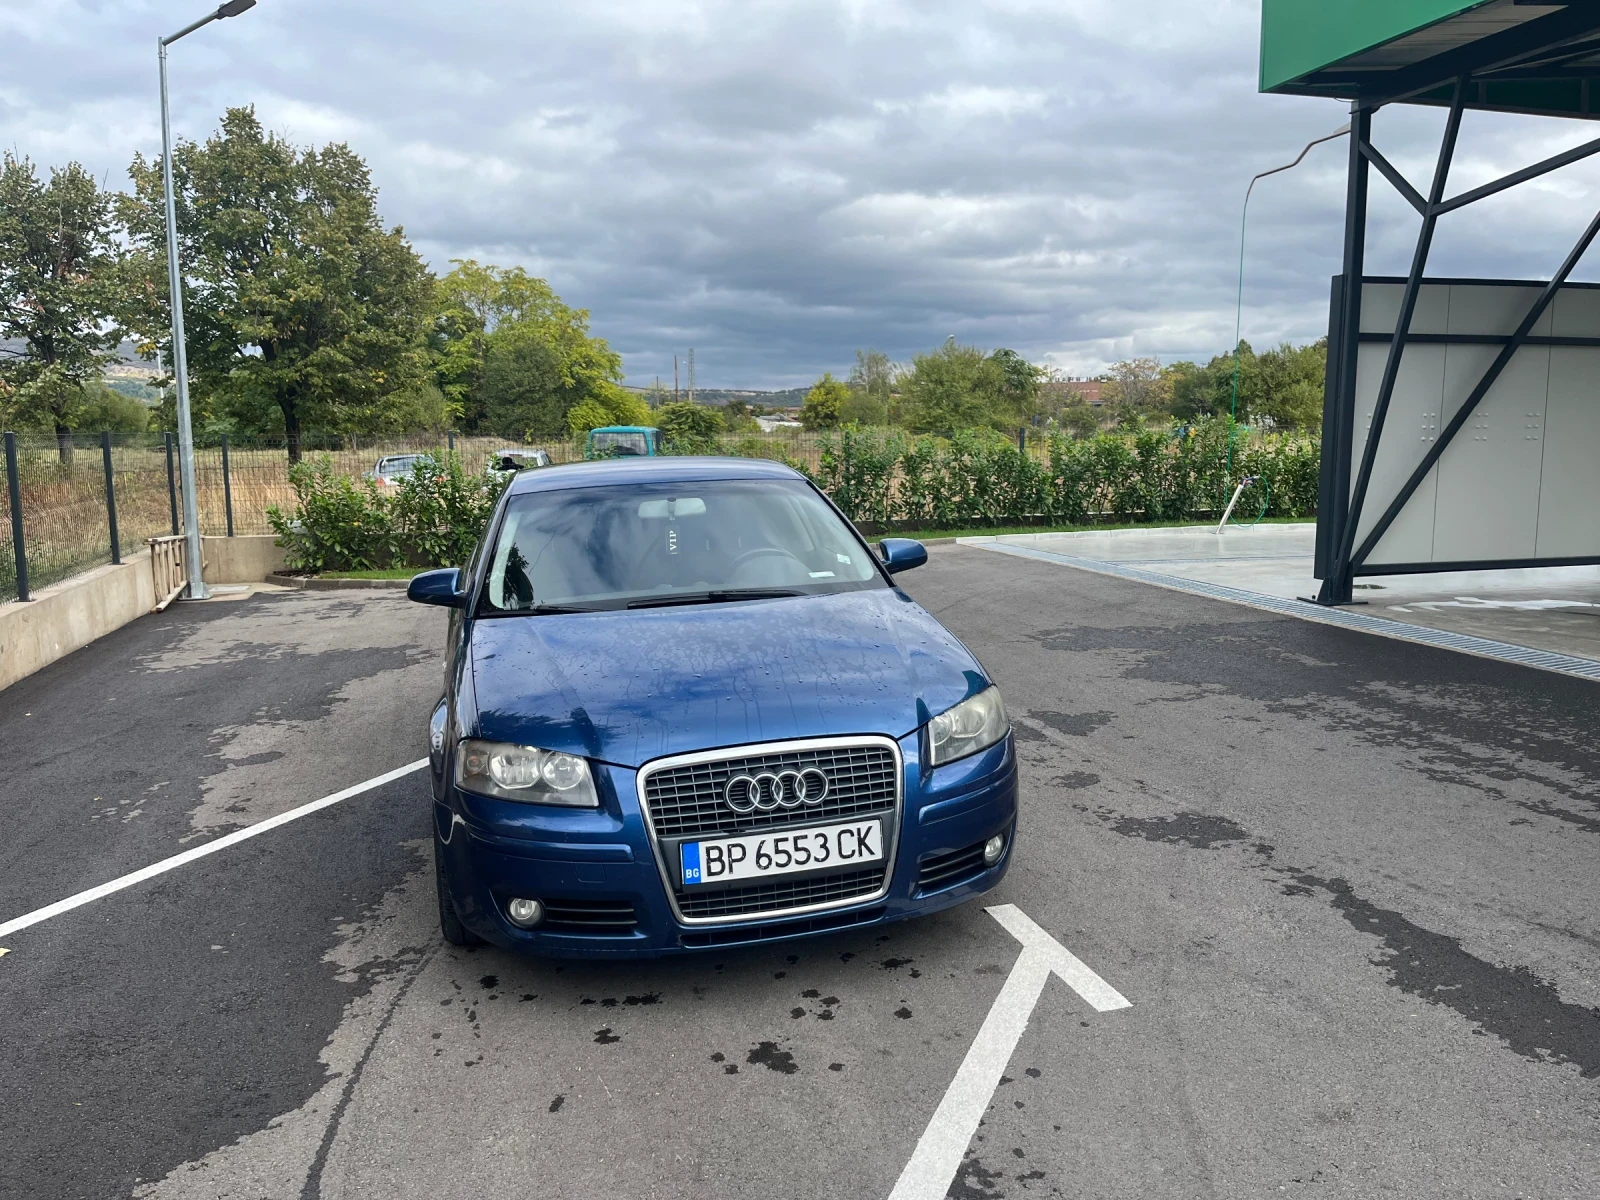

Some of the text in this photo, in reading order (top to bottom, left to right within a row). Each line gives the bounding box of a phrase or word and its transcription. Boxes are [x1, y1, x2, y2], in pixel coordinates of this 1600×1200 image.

[669, 530, 677, 551] VIP
[705, 825, 875, 877] BP 6553 CK
[685, 868, 700, 879] BG
